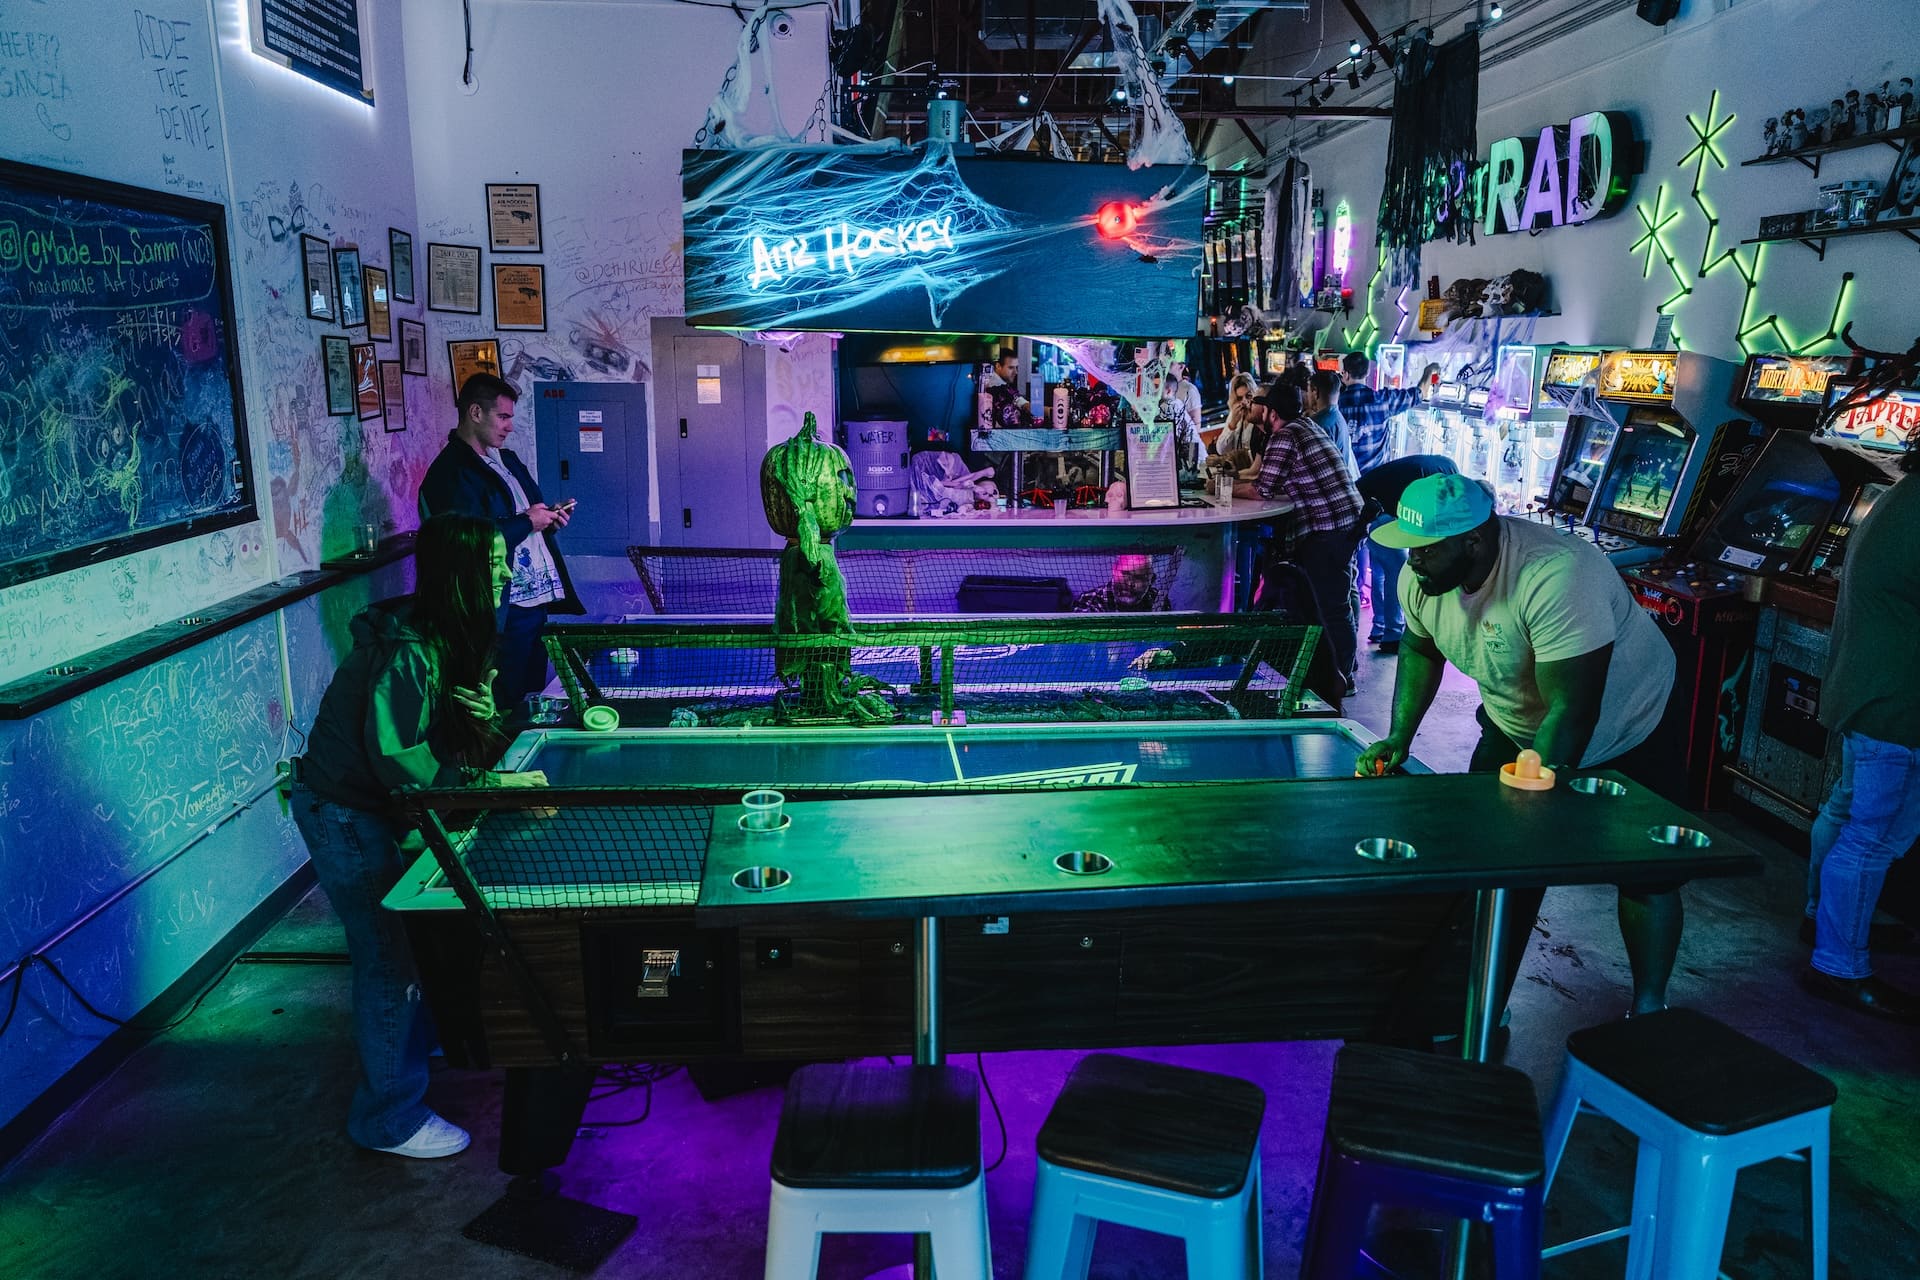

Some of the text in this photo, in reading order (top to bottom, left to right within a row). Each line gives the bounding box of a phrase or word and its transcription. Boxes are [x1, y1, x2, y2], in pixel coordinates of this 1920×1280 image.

[134, 9, 191, 60] RIDE
[152, 67, 188, 98] THE
[825, 214, 954, 275] HOCKEY
[859, 431, 897, 445] WATER!
[1402, 506, 1423, 528] CITY
